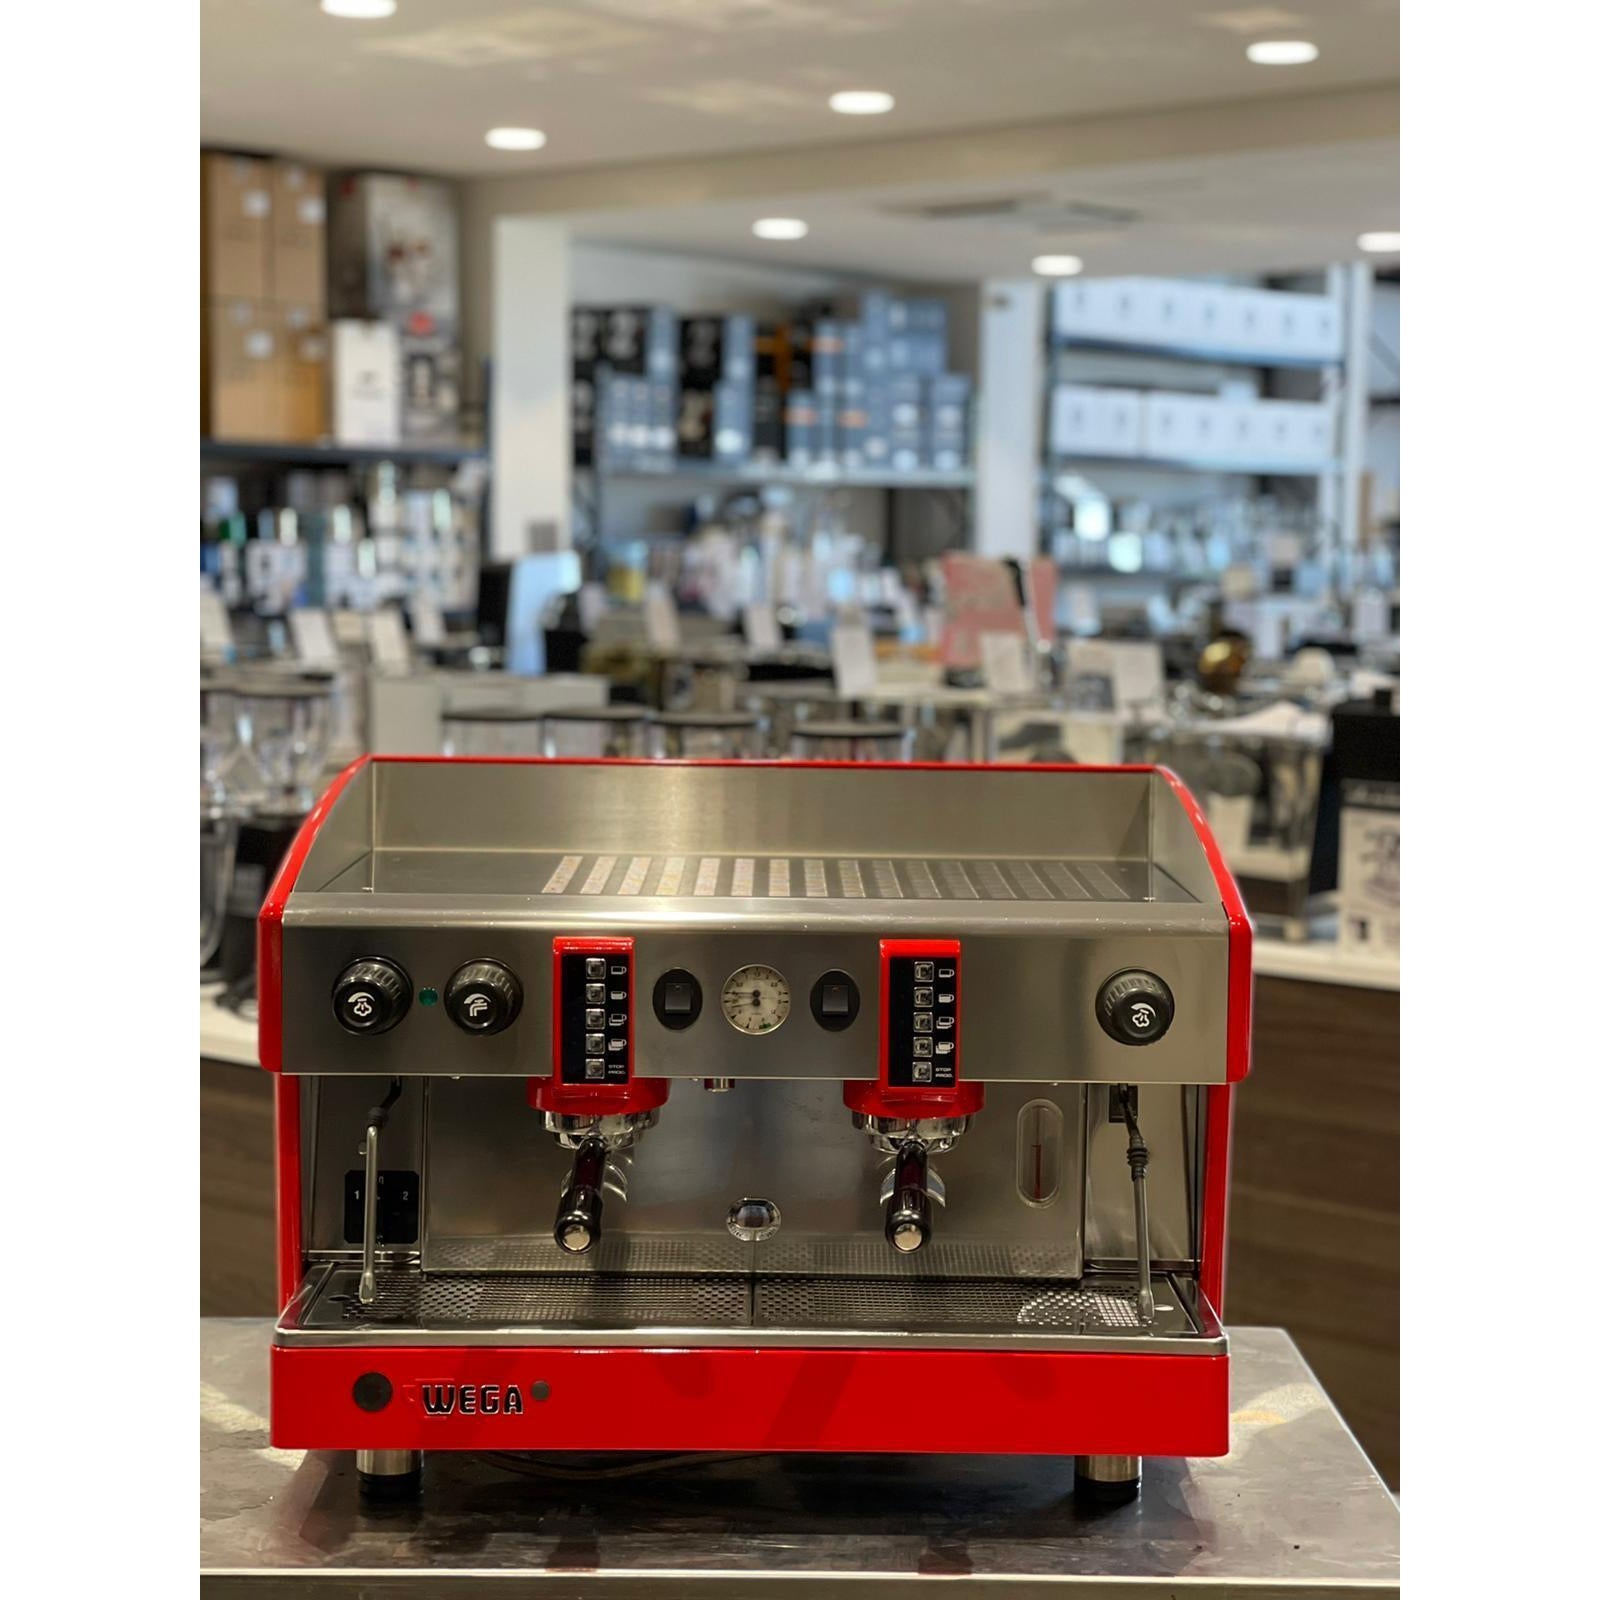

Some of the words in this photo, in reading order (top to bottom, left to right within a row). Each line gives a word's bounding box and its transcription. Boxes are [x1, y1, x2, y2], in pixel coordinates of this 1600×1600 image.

[354, 1190, 360, 1200] 1
[402, 1191, 409, 1200] 2
[422, 1384, 524, 1415] WEGA
